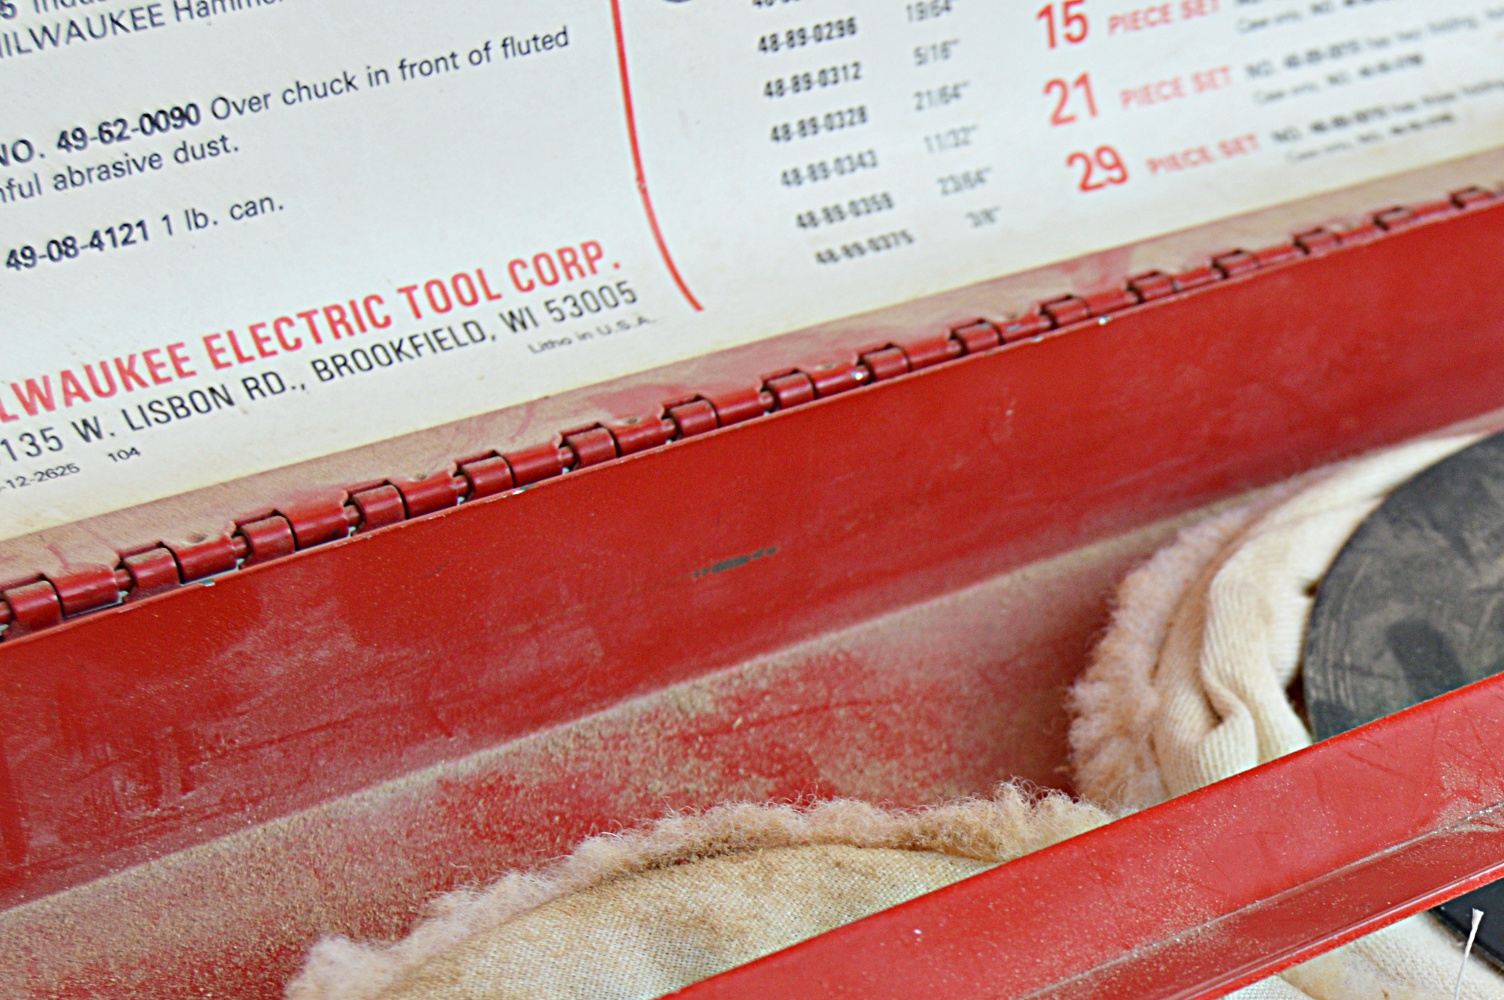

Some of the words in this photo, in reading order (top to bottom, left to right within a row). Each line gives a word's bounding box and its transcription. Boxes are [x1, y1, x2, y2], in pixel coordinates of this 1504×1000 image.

[0, 3, 166, 58] ILWAUKEE
[757, 17, 858, 54] 48-89-0296
[1036, 0, 1089, 49] 15
[1108, 4, 1173, 35] PIECE
[1180, 0, 1220, 20] SET
[56, 103, 201, 152] 49-62-0090
[211, 93, 271, 120] Over
[282, 71, 359, 106] chuck
[366, 66, 390, 87] in
[398, 51, 460, 81] front
[468, 41, 492, 66] of
[501, 26, 569, 59] fluted
[764, 62, 862, 98] 48-89-0312
[1043, 71, 1098, 126] 21
[1120, 77, 1187, 108] PIECE
[1191, 66, 1232, 93] SET
[770, 105, 868, 142] 48-89-0328
[53, 151, 163, 192] abrasive
[173, 134, 239, 164] dust.
[781, 150, 878, 187] 48-89-0343
[1066, 145, 1129, 192] 29
[1146, 146, 1216, 174] PIECE
[5, 219, 149, 271] 49-08-4121
[161, 214, 173, 236] 1
[184, 208, 218, 231] lb.
[229, 195, 284, 221] can.
[202, 294, 392, 371] ELECTRIC
[397, 268, 502, 320] TOOL
[507, 240, 620, 293] CORP.
[71, 416, 116, 444] W.
[121, 384, 235, 431] LISBON
[242, 371, 306, 400] RD.,
[311, 320, 497, 382] BROOKFIELD,
[500, 306, 538, 334] WI
[544, 281, 637, 322] 53005
[108, 446, 141, 463] 104
